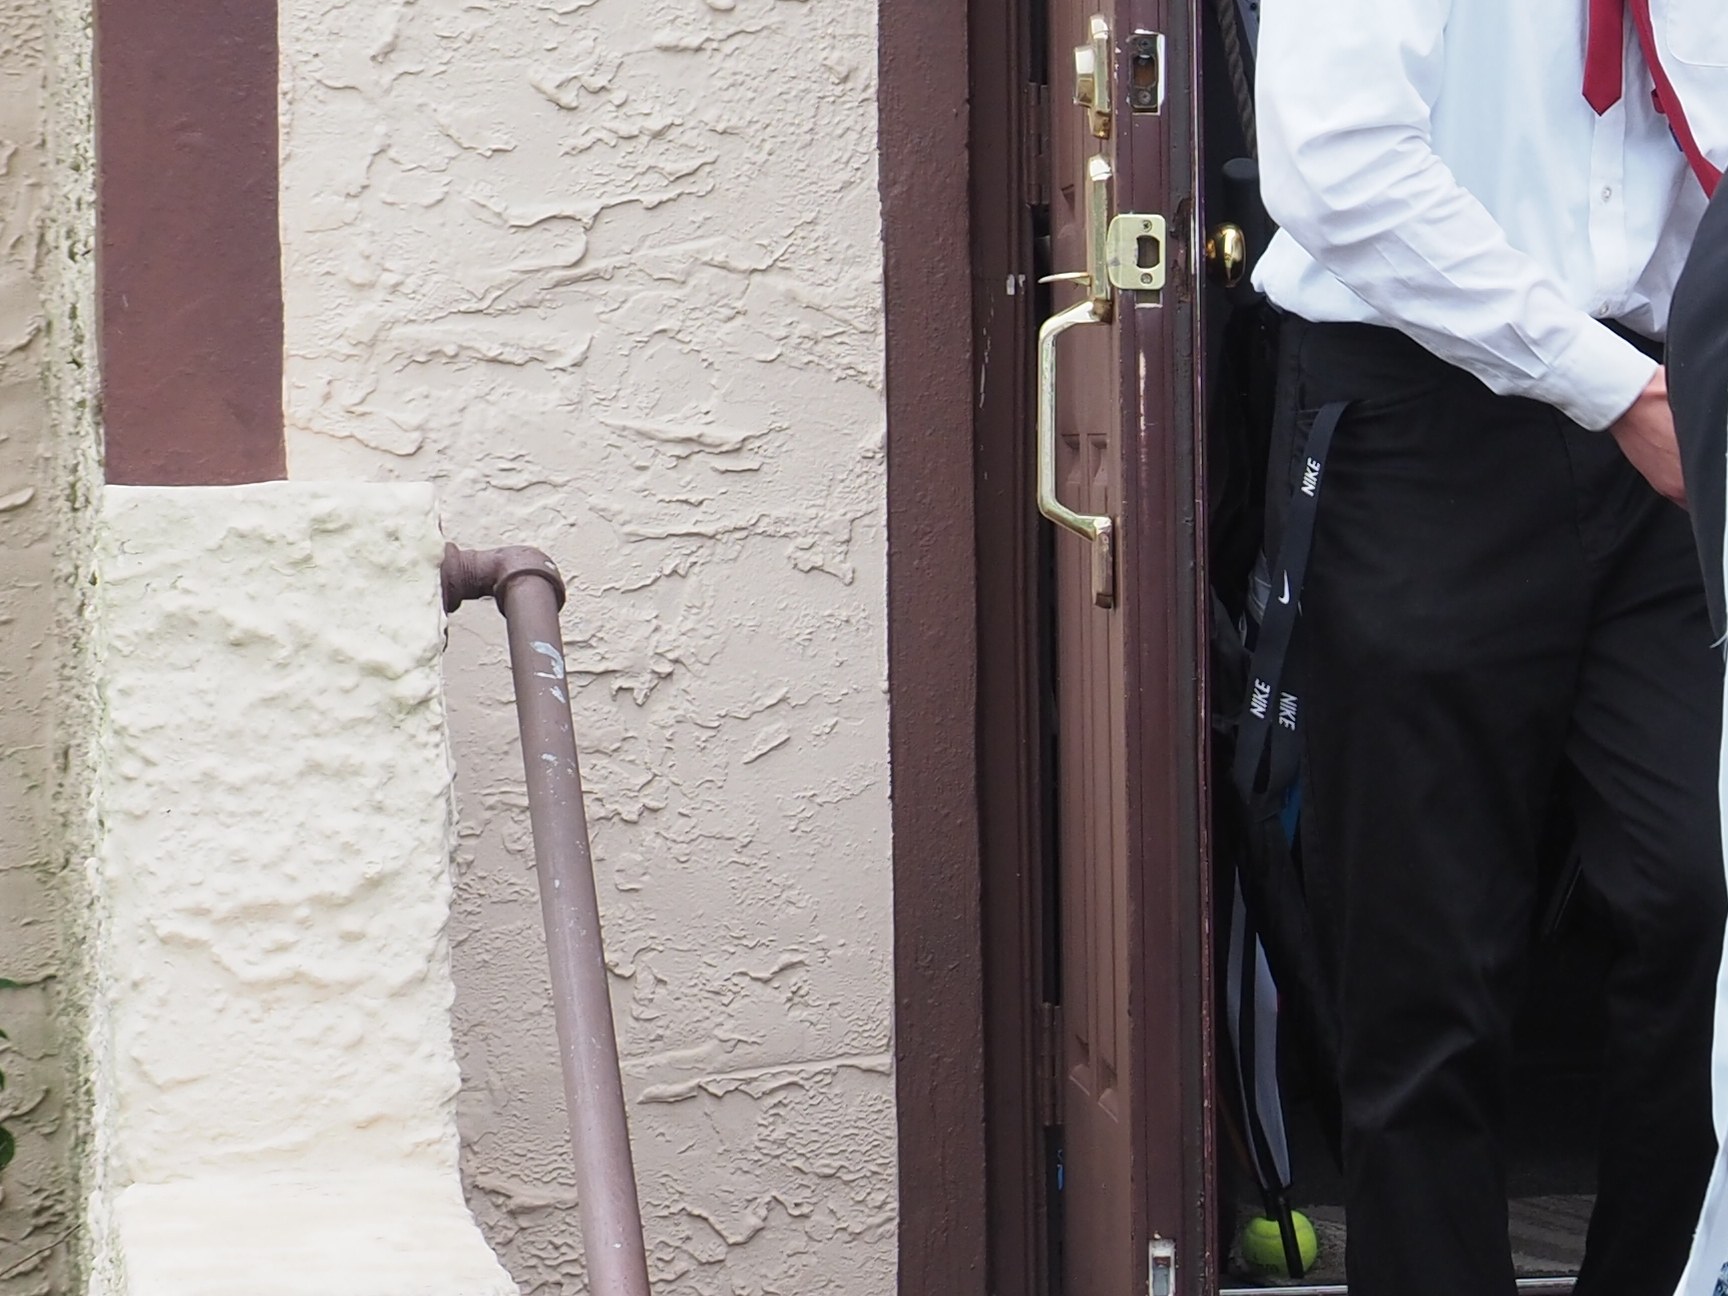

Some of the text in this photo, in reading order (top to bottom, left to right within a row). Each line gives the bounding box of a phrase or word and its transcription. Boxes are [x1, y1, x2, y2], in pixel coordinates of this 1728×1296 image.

[1301, 457, 1321, 497] NIKE
[1250, 679, 1271, 719] NIKE
[1279, 691, 1299, 731] NIKE
